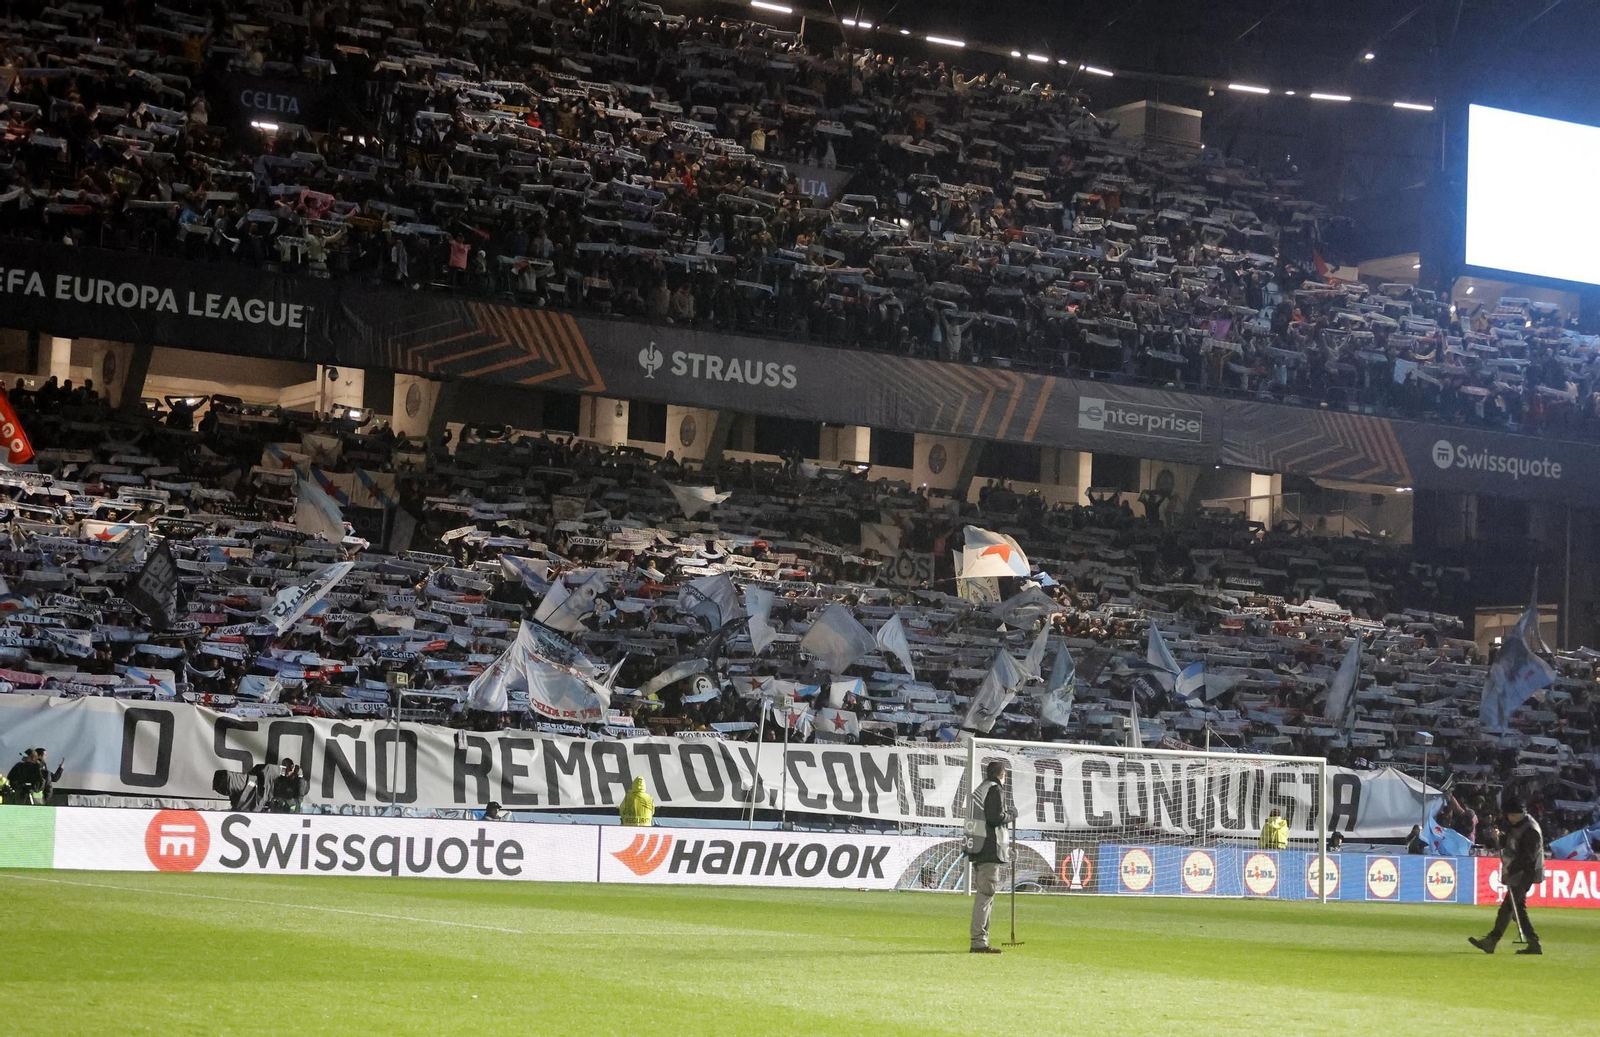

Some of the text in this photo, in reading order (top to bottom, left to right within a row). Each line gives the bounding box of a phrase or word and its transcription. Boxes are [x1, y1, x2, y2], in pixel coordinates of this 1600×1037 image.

[240, 88, 301, 115] CELTA
[55, 274, 178, 314] EUROPA
[671, 351, 797, 389] STRAUSS
[1079, 405, 1200, 433] enterprise
[1456, 444, 1562, 479] Swissquote
[563, 710, 577, 718] DE
[120, 707, 174, 788] O
[214, 713, 417, 804] SOÑO
[453, 736, 778, 808] REMATOU,
[1034, 758, 1065, 823] A
[1081, 760, 1361, 833] CONQUISTA
[219, 814, 524, 877] Swissquote
[1123, 861, 1151, 875] LIDL
[1185, 863, 1213, 877] LIDL
[1246, 865, 1275, 880] LIDL
[1370, 870, 1395, 884] LIDL
[1428, 871, 1453, 885] LIDL
